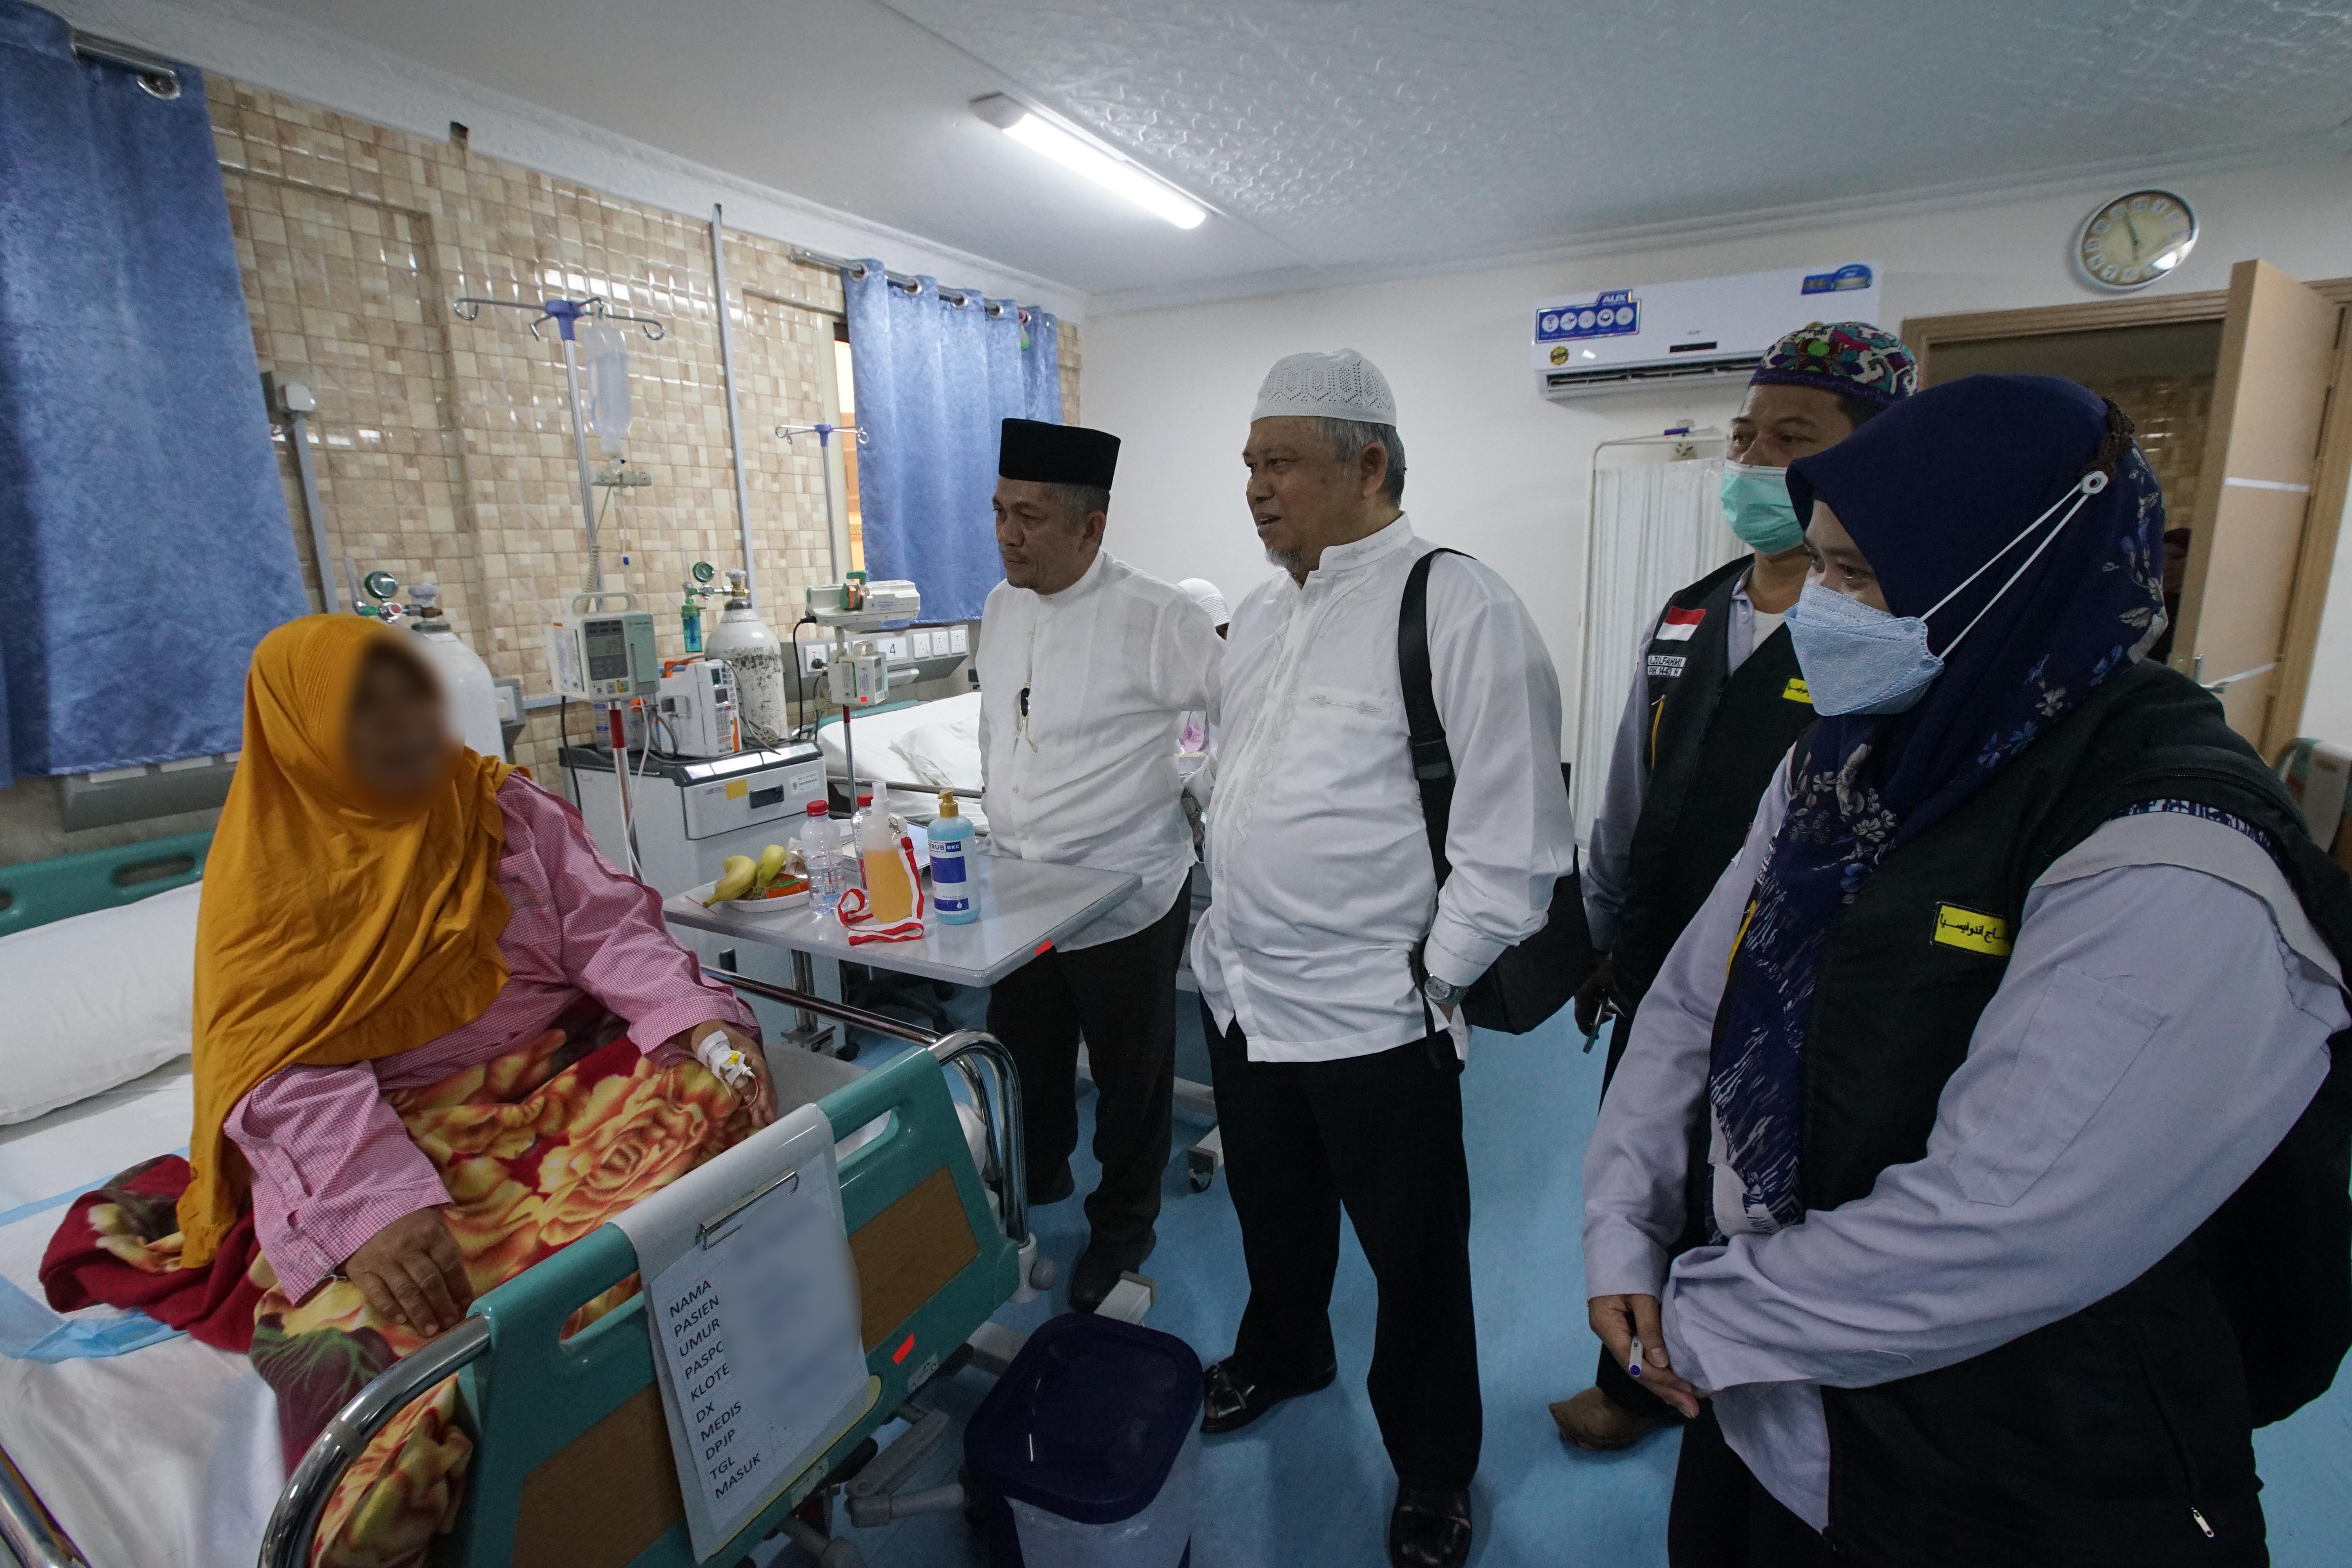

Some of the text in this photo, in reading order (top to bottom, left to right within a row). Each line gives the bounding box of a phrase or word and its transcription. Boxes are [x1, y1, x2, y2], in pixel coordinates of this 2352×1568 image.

[890, 644, 896, 655] 4
[670, 1280, 711, 1318] NAMA
[674, 1295, 719, 1338] PASIEN
[679, 1318, 720, 1357] UMUR
[696, 1401, 715, 1423] DX
[701, 1401, 742, 1442] MEDIS
[706, 1429, 735, 1460] DPJP
[710, 1457, 735, 1479] TGL
[715, 1452, 761, 1499] MASUK
